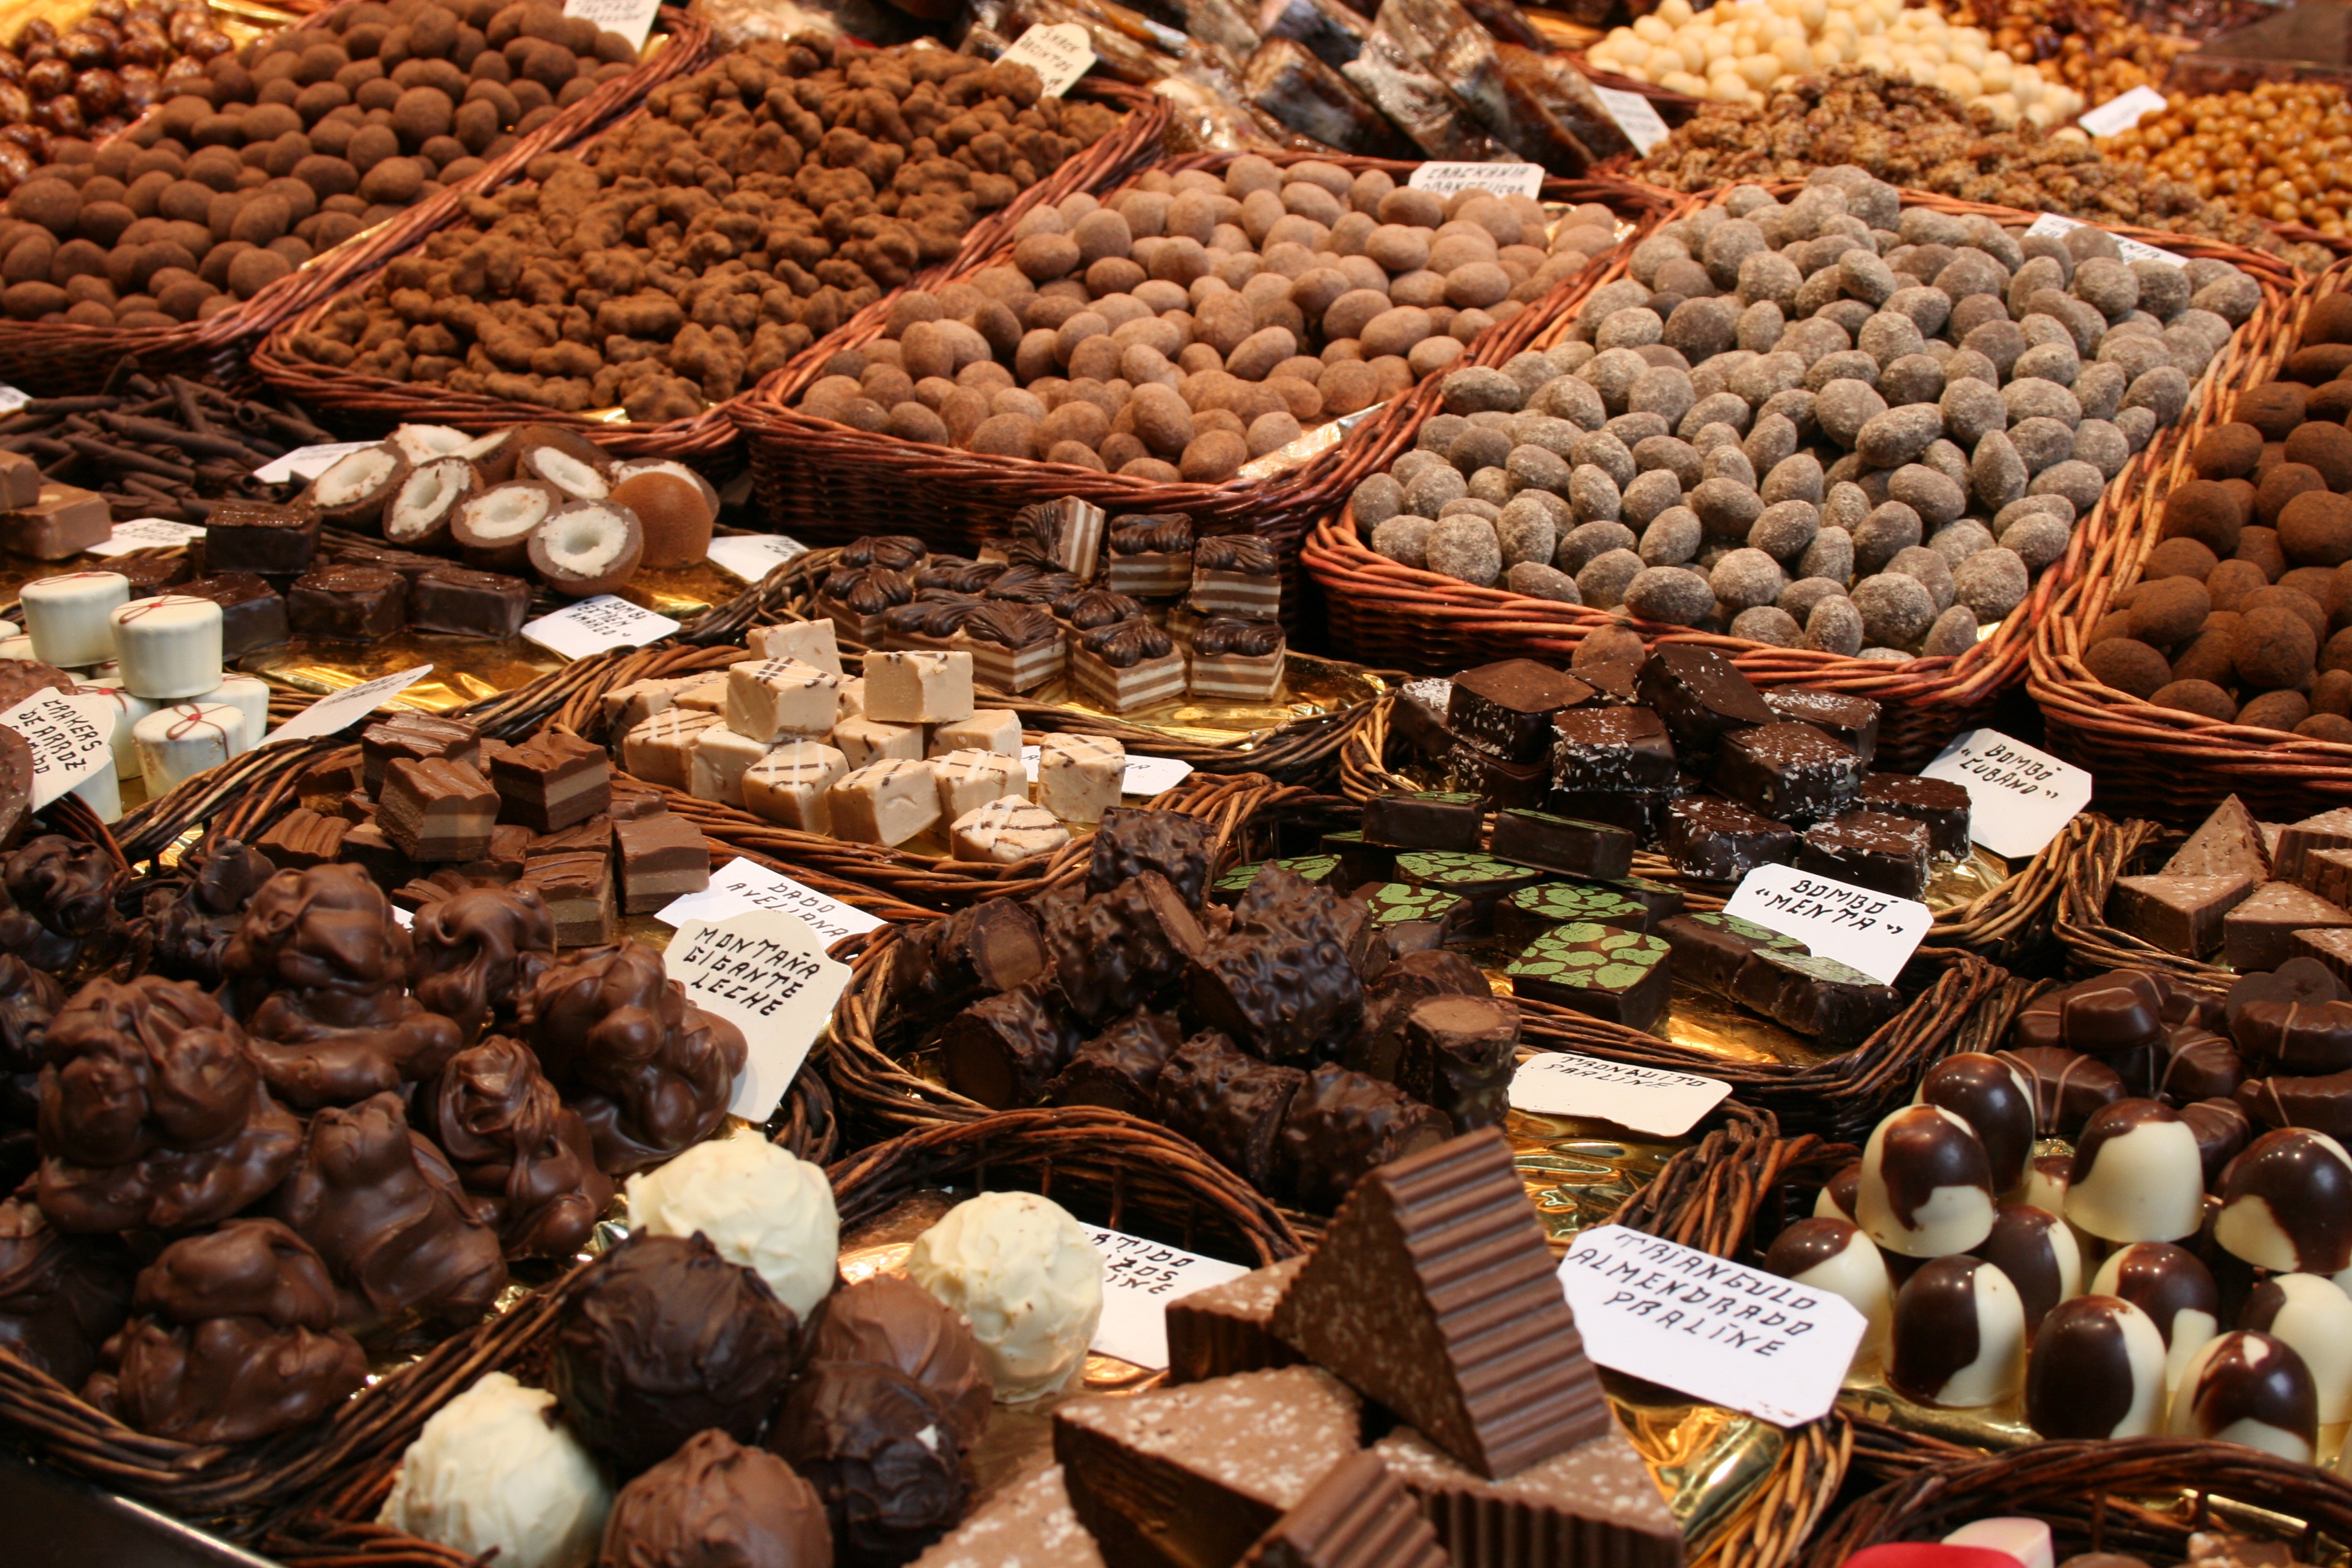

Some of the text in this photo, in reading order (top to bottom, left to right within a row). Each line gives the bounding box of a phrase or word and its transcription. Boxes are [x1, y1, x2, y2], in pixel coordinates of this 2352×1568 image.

[18, 707, 46, 727] DE
[31, 725, 87, 771] ARROZ
[766, 883, 836, 913] DADO
[682, 946, 805, 998] GIGANTE
[690, 973, 784, 1016] LECHE
[1567, 1248, 1815, 1336] ALMENDRADO
[1615, 1233, 1817, 1310] TRIANGULO
